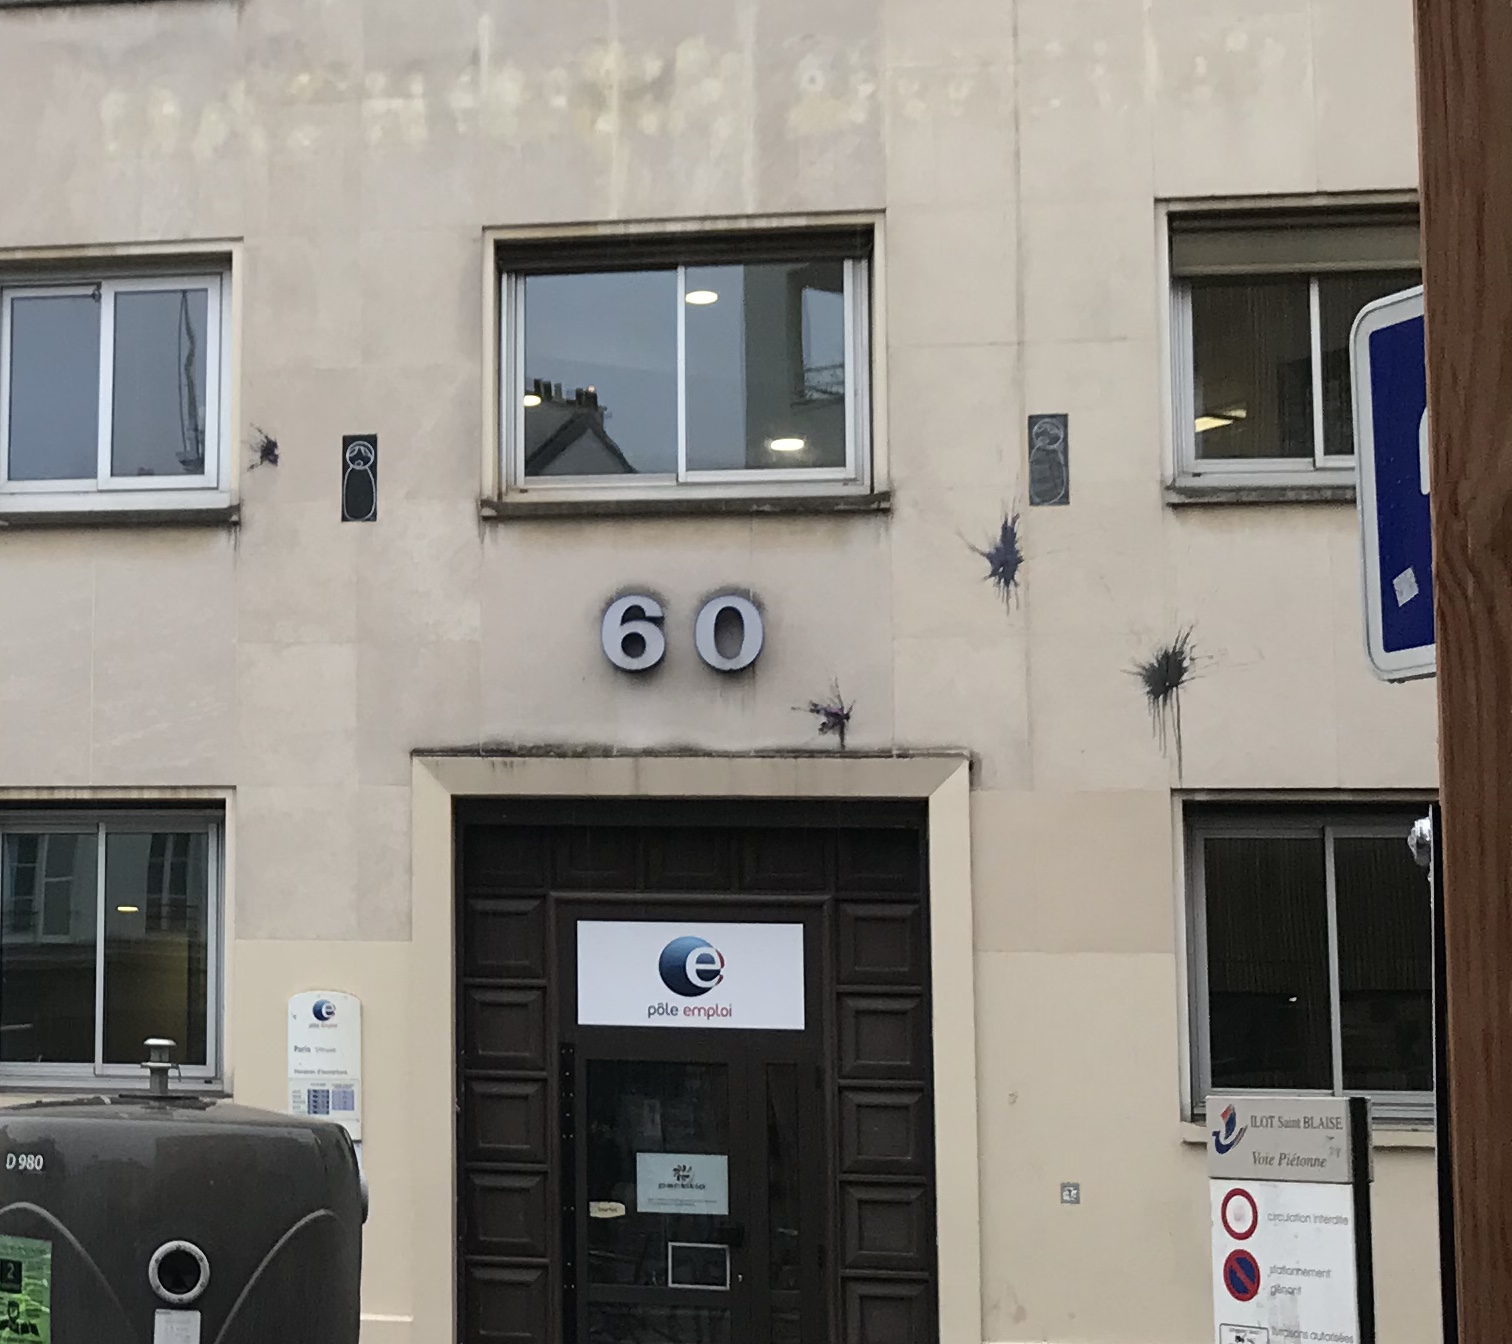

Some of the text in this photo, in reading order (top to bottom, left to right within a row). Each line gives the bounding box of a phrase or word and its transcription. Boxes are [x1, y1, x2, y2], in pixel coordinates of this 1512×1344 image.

[601, 594, 764, 672] 60
[647, 1002, 733, 1020] pôle emploi
[1250, 1115, 1344, 1130] ILOT Saint BLAISE
[6, 1152, 44, 1171] D 980
[1252, 1151, 1327, 1168] Voie Piétonne
[1267, 1212, 1348, 1225] circulation interdite
[1269, 1265, 1332, 1278] stationnement
[1270, 1284, 1302, 1296] gênant
[1310, 1330, 1354, 1344] autorisées
